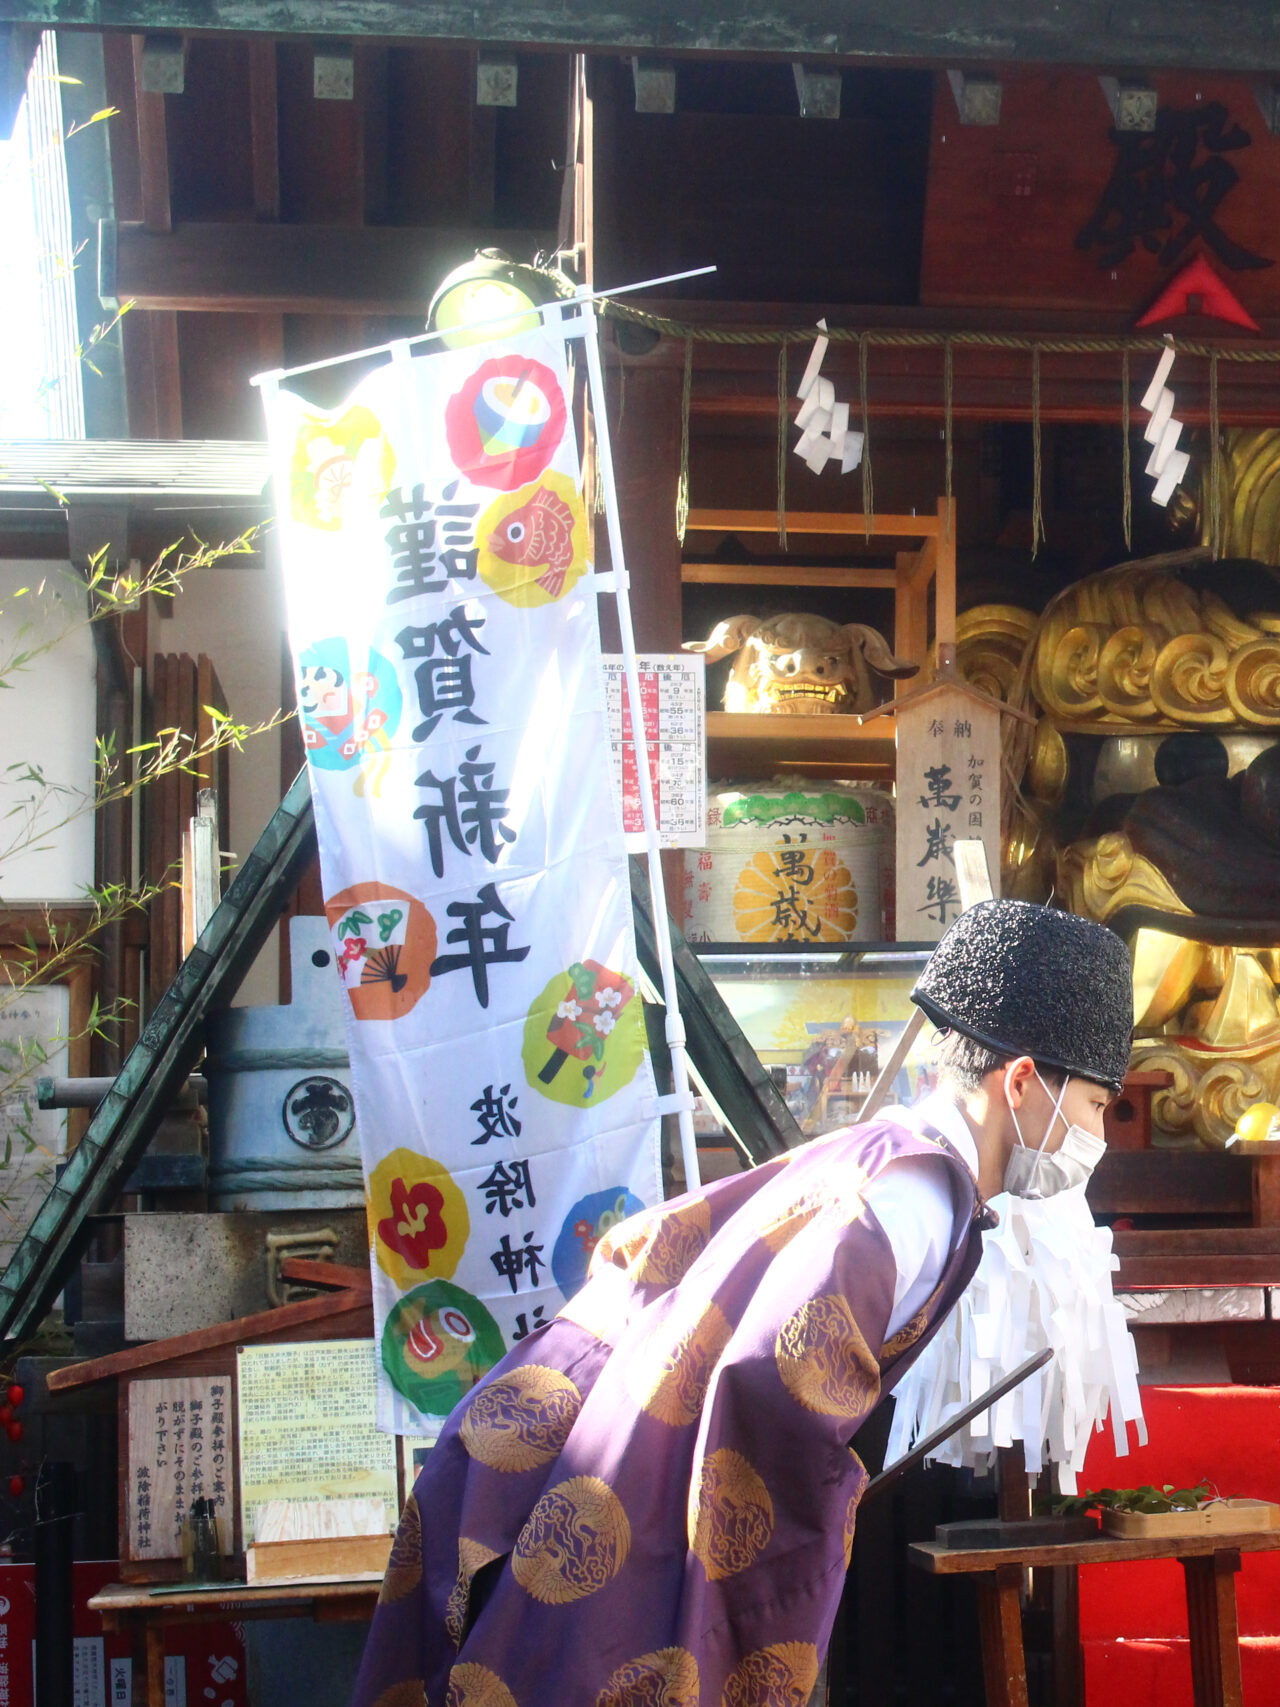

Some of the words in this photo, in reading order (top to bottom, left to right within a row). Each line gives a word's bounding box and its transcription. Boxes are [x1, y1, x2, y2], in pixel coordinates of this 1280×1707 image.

[928, 719, 972, 739] 奉納
[968, 754, 985, 841] 加賀の国
[189, 1400, 204, 1504] 獅子殿のご参拝
